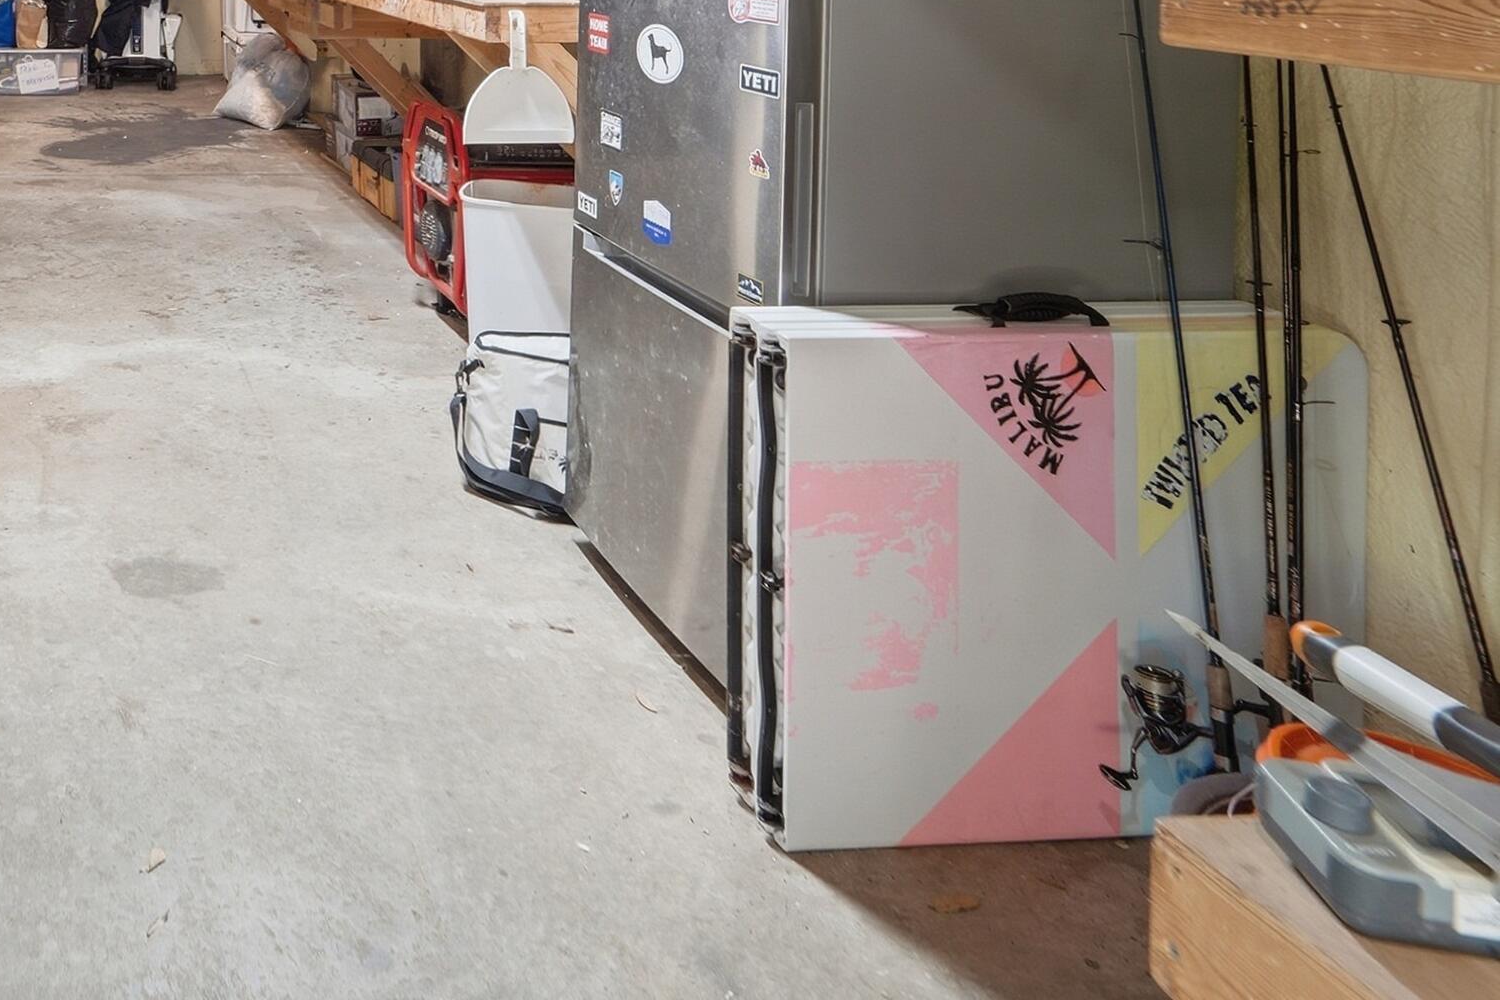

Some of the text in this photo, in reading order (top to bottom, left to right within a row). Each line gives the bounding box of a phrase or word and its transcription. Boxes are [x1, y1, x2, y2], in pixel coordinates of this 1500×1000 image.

[742, 72, 777, 94] YETI
[578, 195, 597, 216] YETI
[983, 373, 1064, 476] MALIBU
